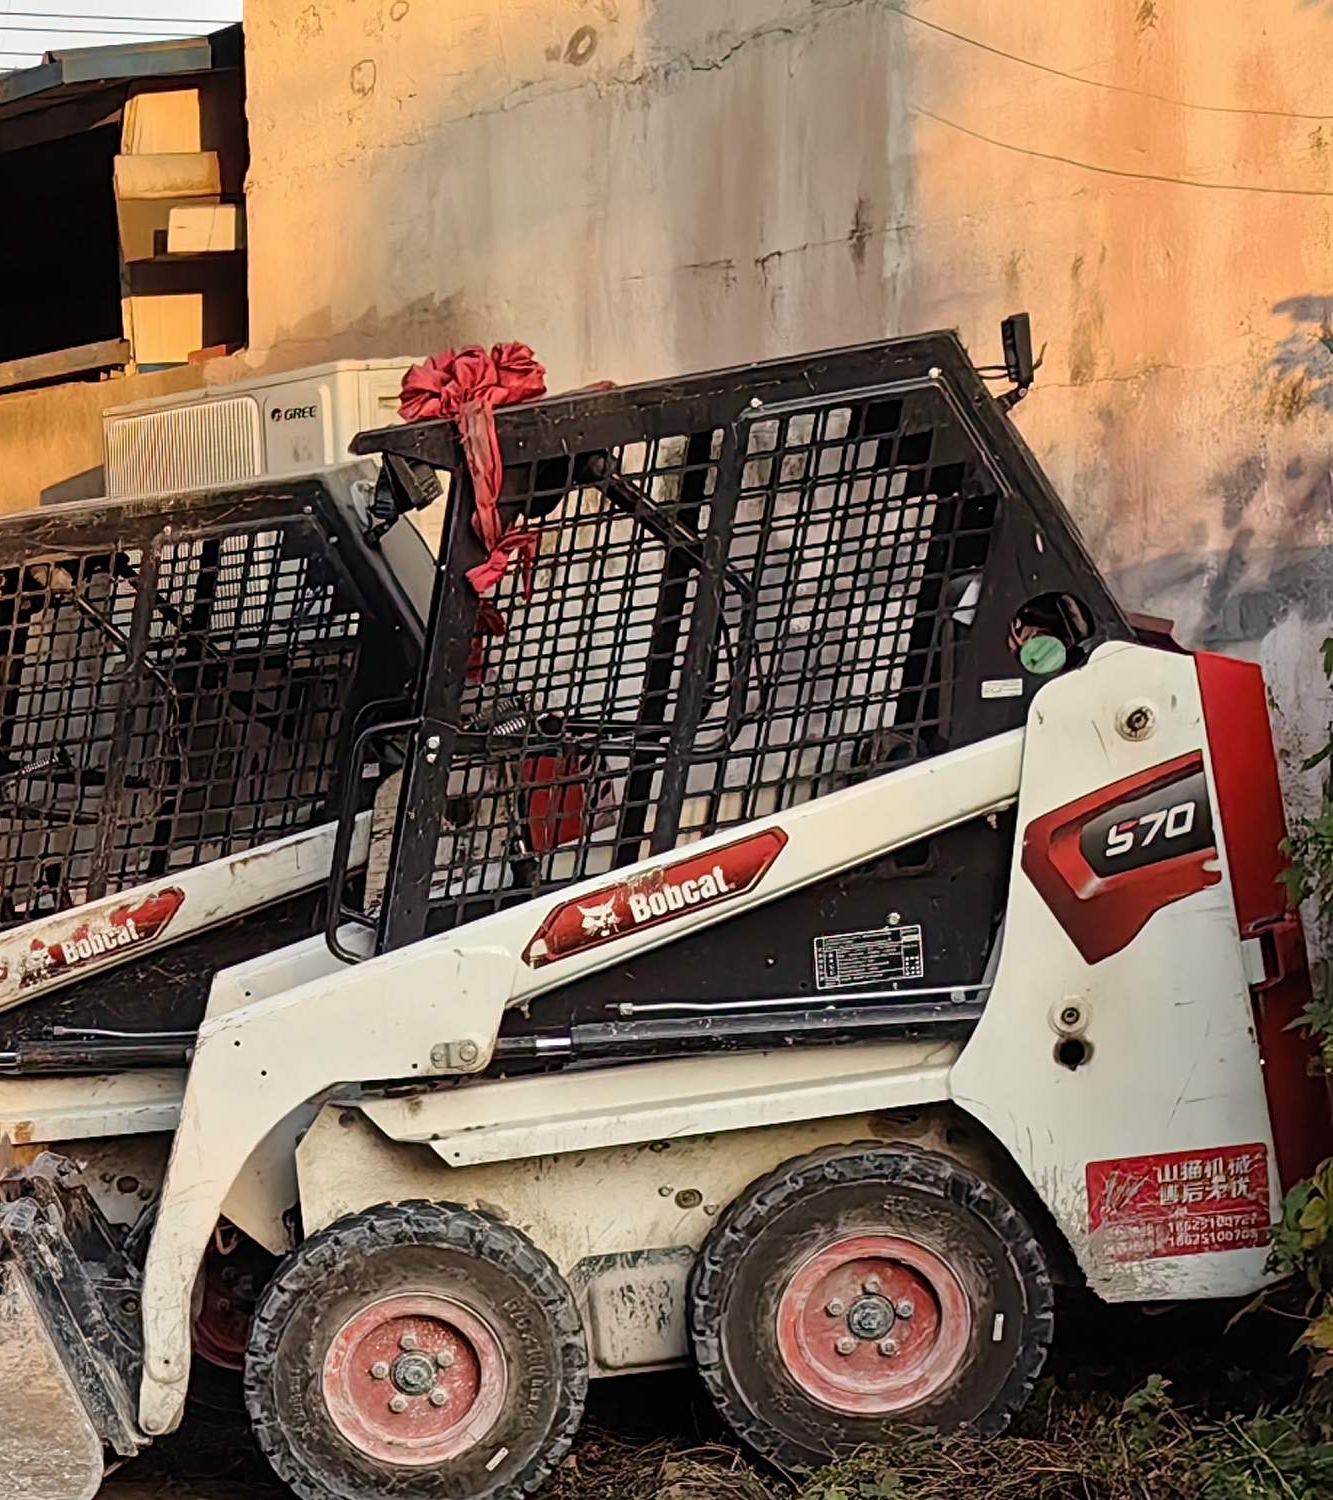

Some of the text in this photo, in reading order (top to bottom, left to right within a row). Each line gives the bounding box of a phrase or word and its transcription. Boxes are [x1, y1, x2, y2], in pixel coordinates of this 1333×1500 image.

[283, 404, 317, 421] GREE
[1105, 802, 1196, 857] S70
[629, 866, 729, 923] Bobcat
[61, 917, 140, 965] Bobcat
